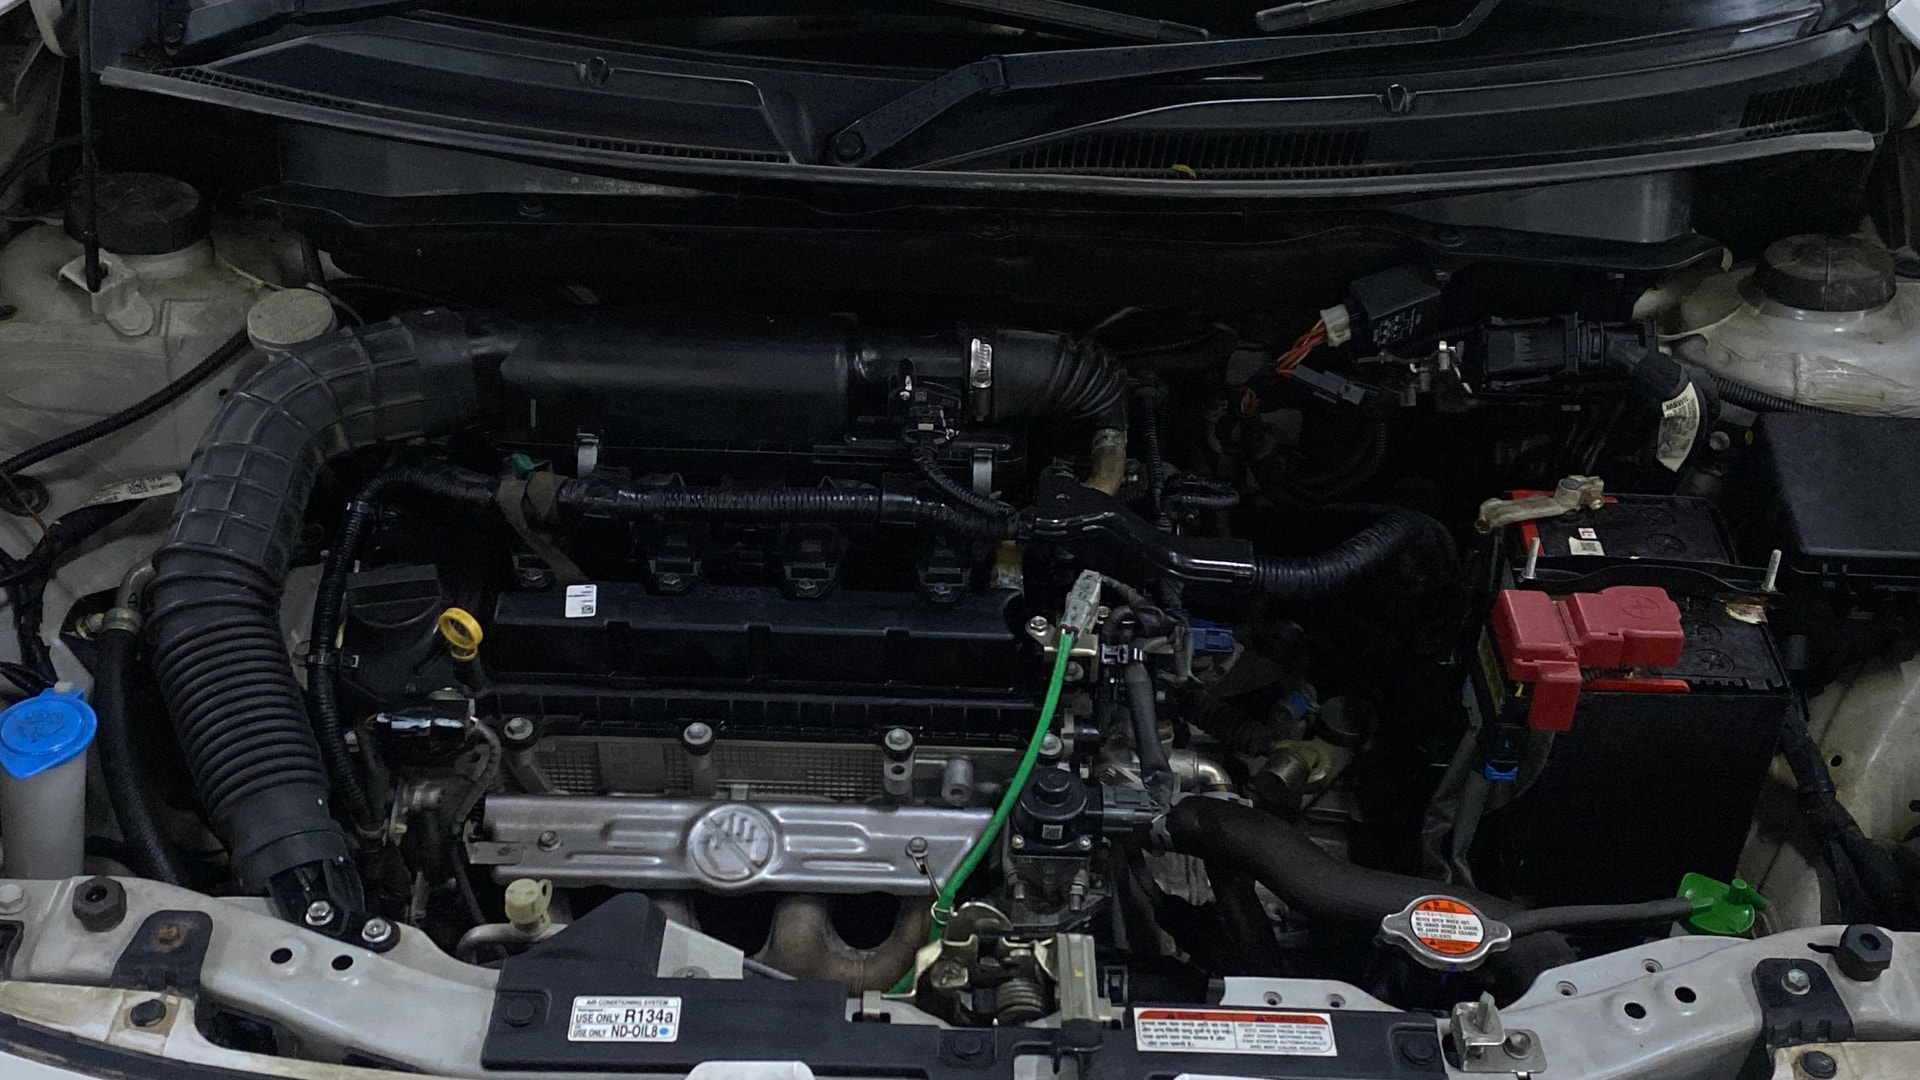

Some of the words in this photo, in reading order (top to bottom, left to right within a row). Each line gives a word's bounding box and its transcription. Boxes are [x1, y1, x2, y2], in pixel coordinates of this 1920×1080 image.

[576, 1014, 593, 1023] USE
[596, 1014, 620, 1023] ONLY
[624, 1009, 673, 1023] R134a
[611, 1025, 658, 1038] ND-OIL8
